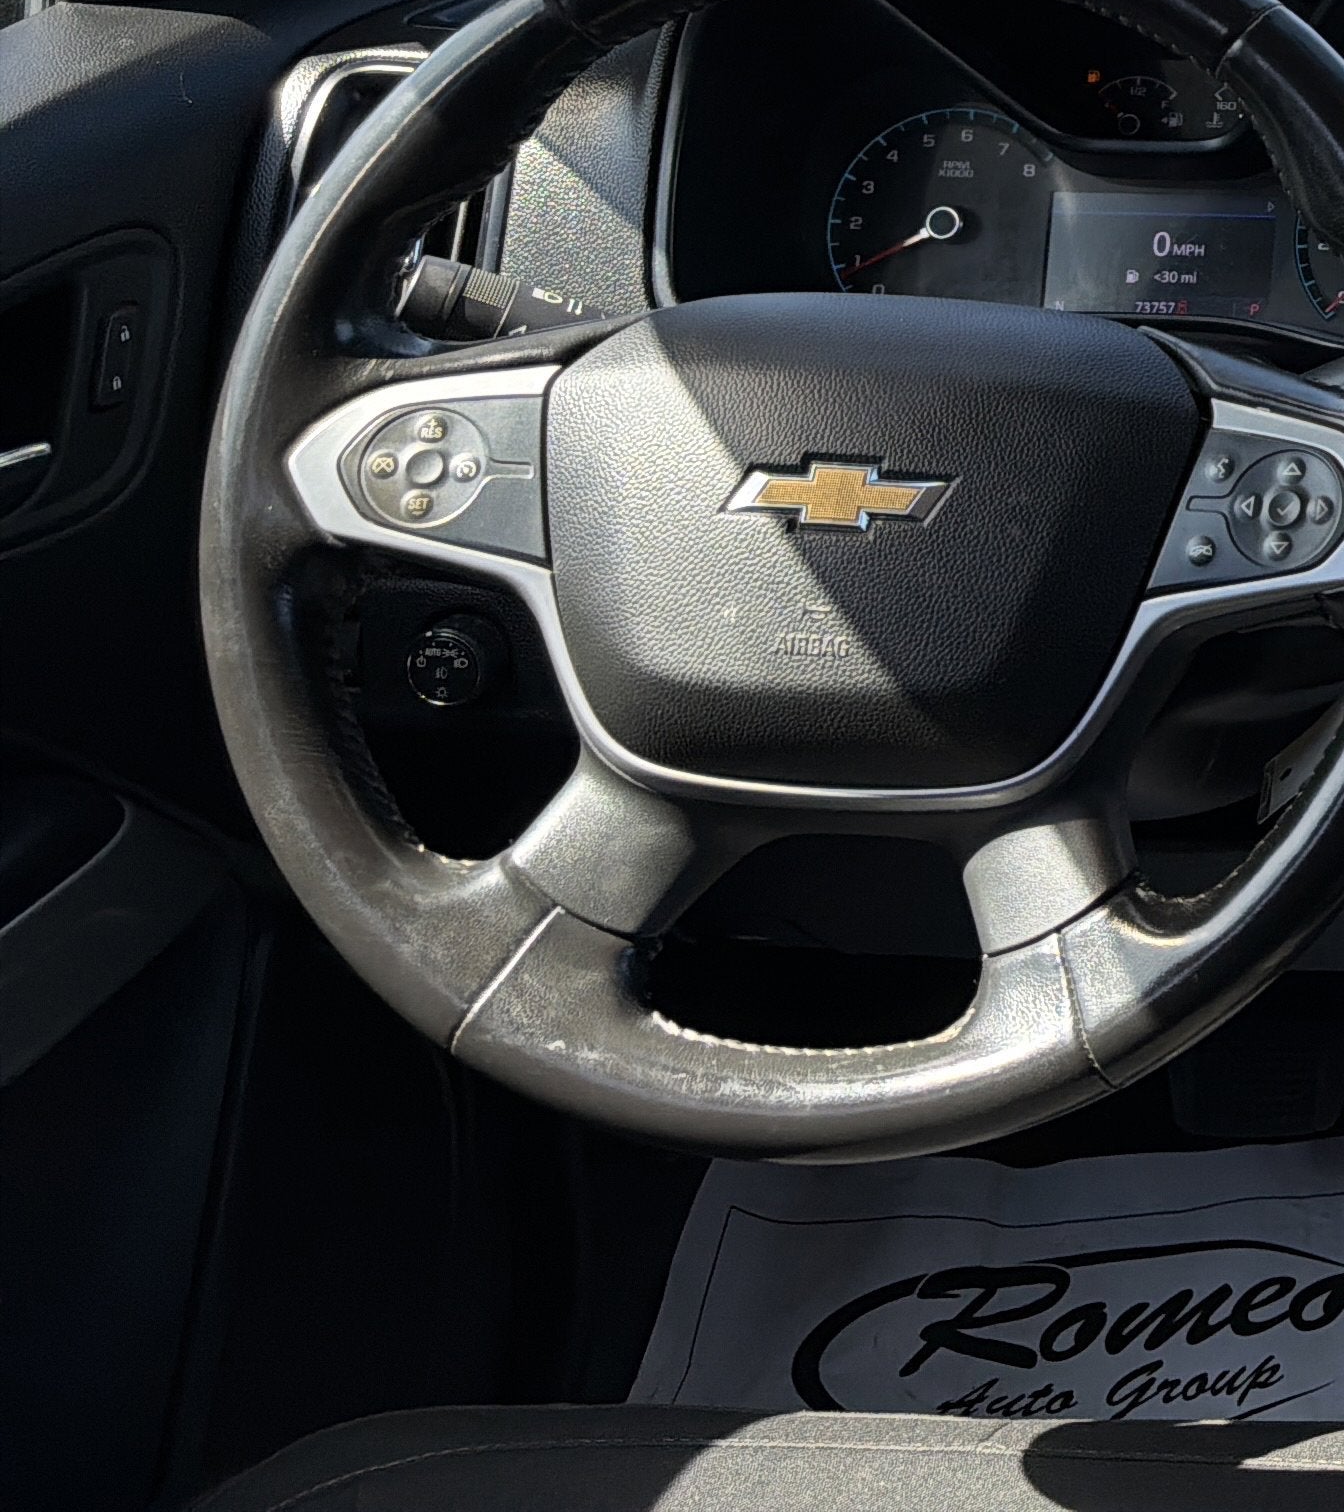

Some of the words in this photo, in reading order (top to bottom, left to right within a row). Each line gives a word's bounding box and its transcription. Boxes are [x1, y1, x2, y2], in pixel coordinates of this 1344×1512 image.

[1216, 101, 1237, 111] 160
[922, 133, 936, 148] 5
[961, 129, 974, 143] 6
[886, 149, 899, 163] 4
[998, 142, 1010, 156] 7
[943, 160, 970, 169] RPM
[1022, 163, 1036, 177] 8
[862, 180, 875, 194] 3
[849, 216, 863, 230] 2
[1153, 231, 1171, 257] 0
[1172, 244, 1205, 257] MPH
[1181, 271, 1198, 284] mi
[1135, 301, 1175, 314] 73757
[1249, 301, 1262, 316] P
[420, 426, 443, 439] RES
[408, 497, 430, 510] SET
[424, 647, 441, 657] AUTO
[937, 1378, 1075, 1419] Auto
[1108, 1355, 1284, 1420] Group
